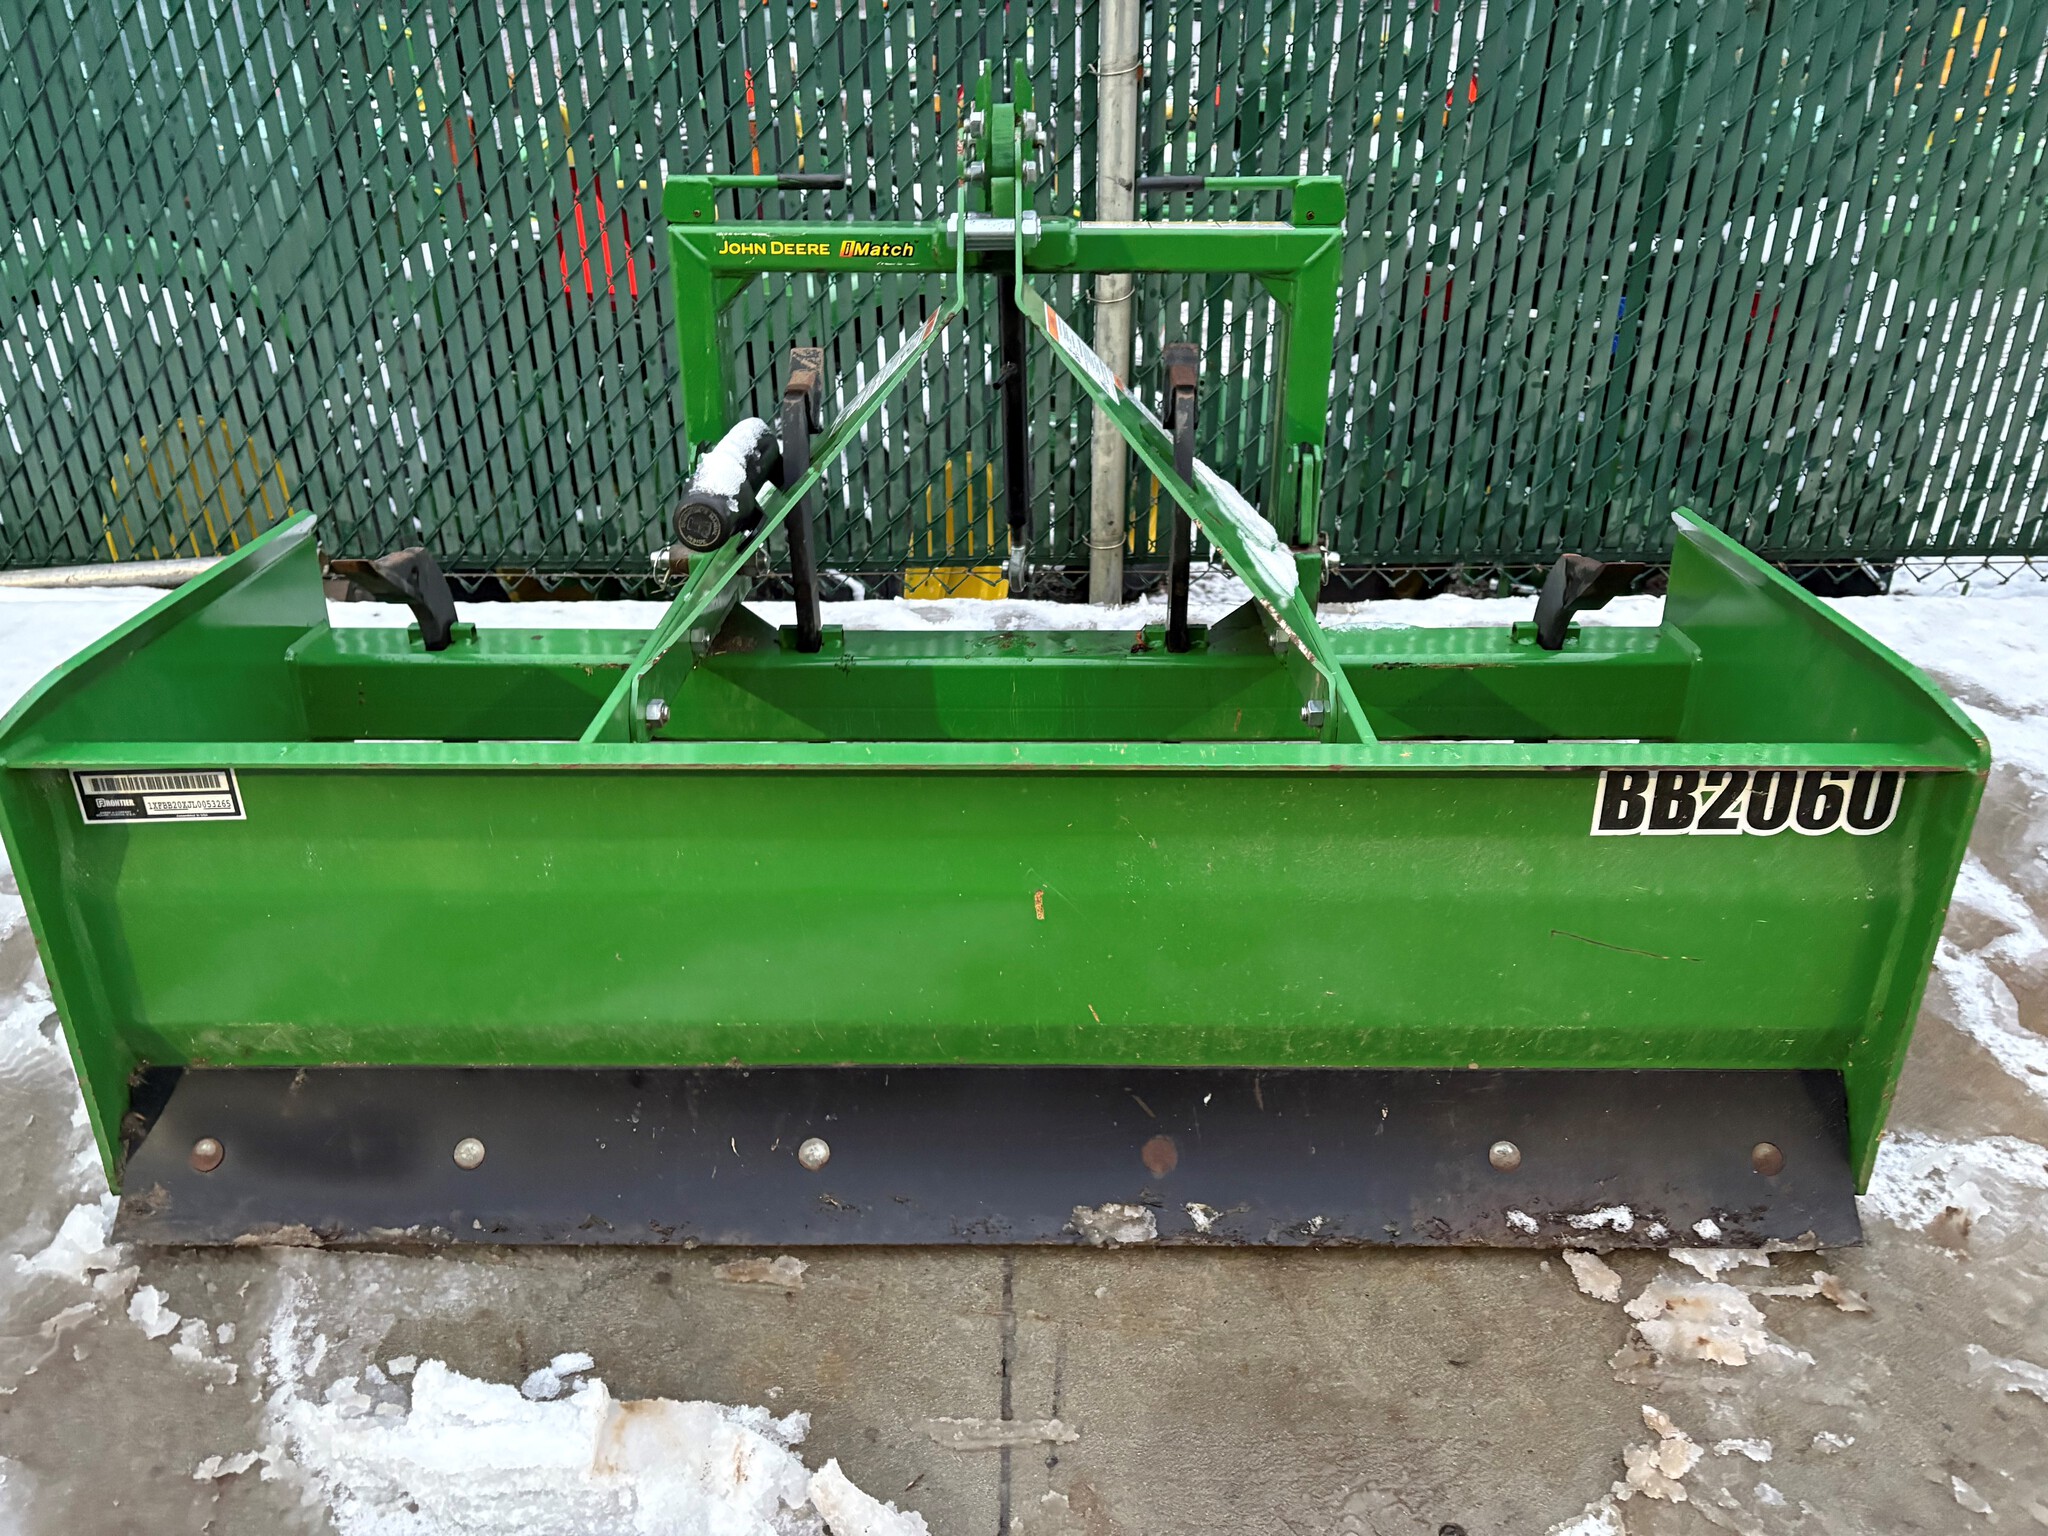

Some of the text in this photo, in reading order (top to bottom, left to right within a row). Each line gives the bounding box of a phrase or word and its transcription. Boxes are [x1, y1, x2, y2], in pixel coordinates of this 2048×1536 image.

[719, 240, 914, 258] JOHN DEERE iMatch
[1592, 770, 1905, 837] BB2060
